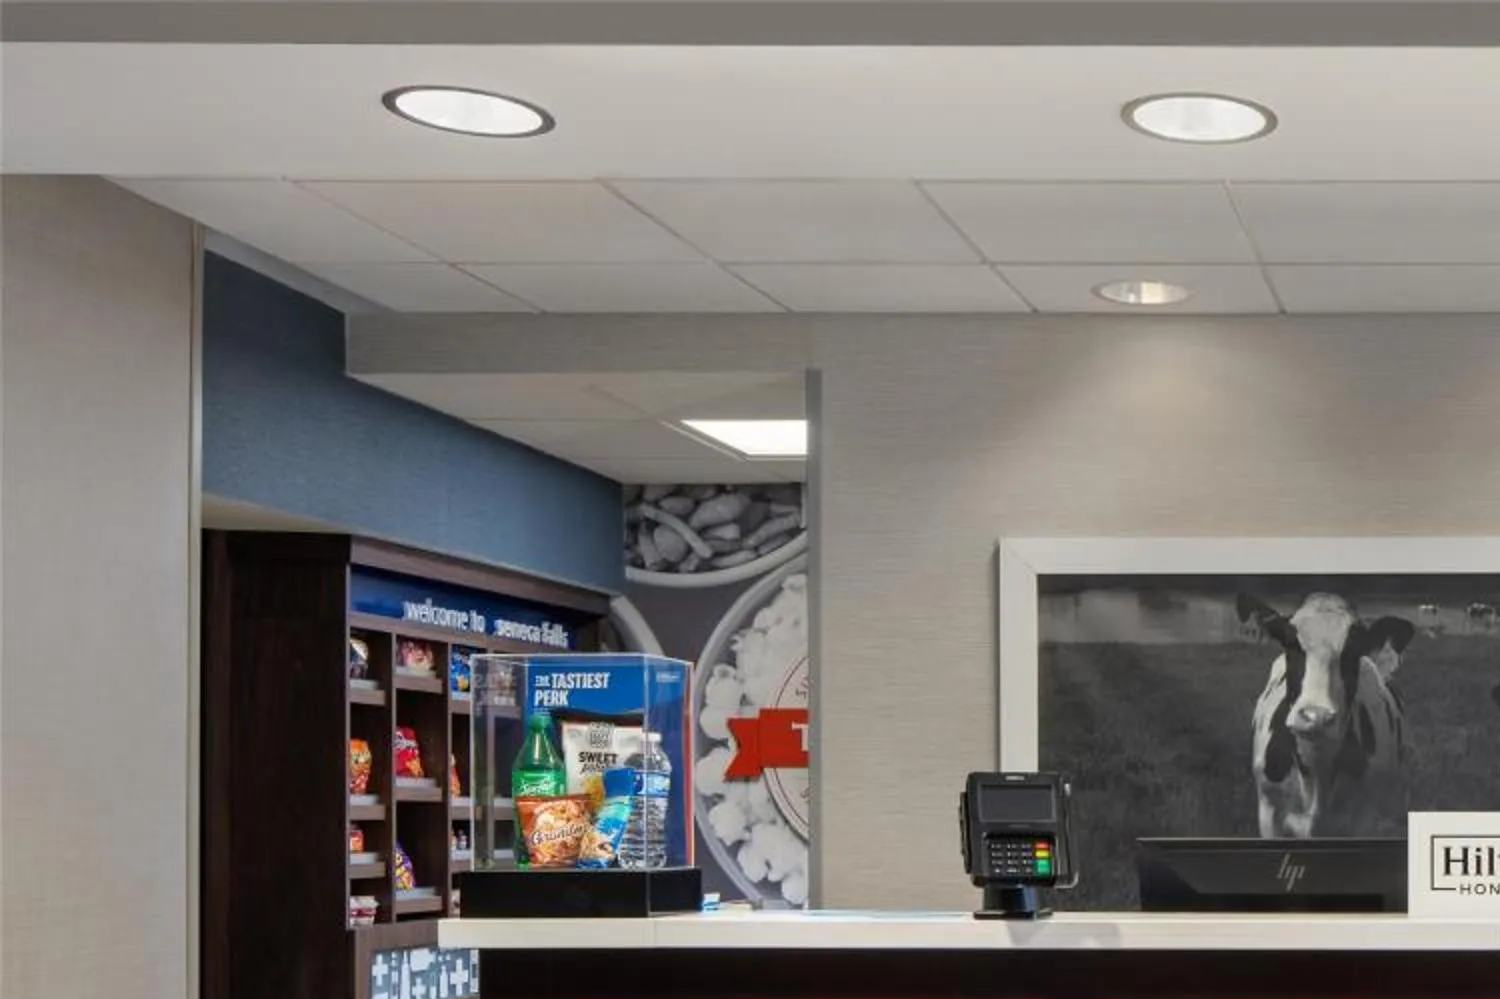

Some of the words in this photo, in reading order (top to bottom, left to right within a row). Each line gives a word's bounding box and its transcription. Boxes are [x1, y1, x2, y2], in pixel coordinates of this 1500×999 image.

[404, 599, 468, 630] welcome
[469, 609, 486, 633] to
[551, 672, 611, 689] TASTIEST
[534, 689, 569, 706] PERK
[578, 751, 618, 765] SWEET
